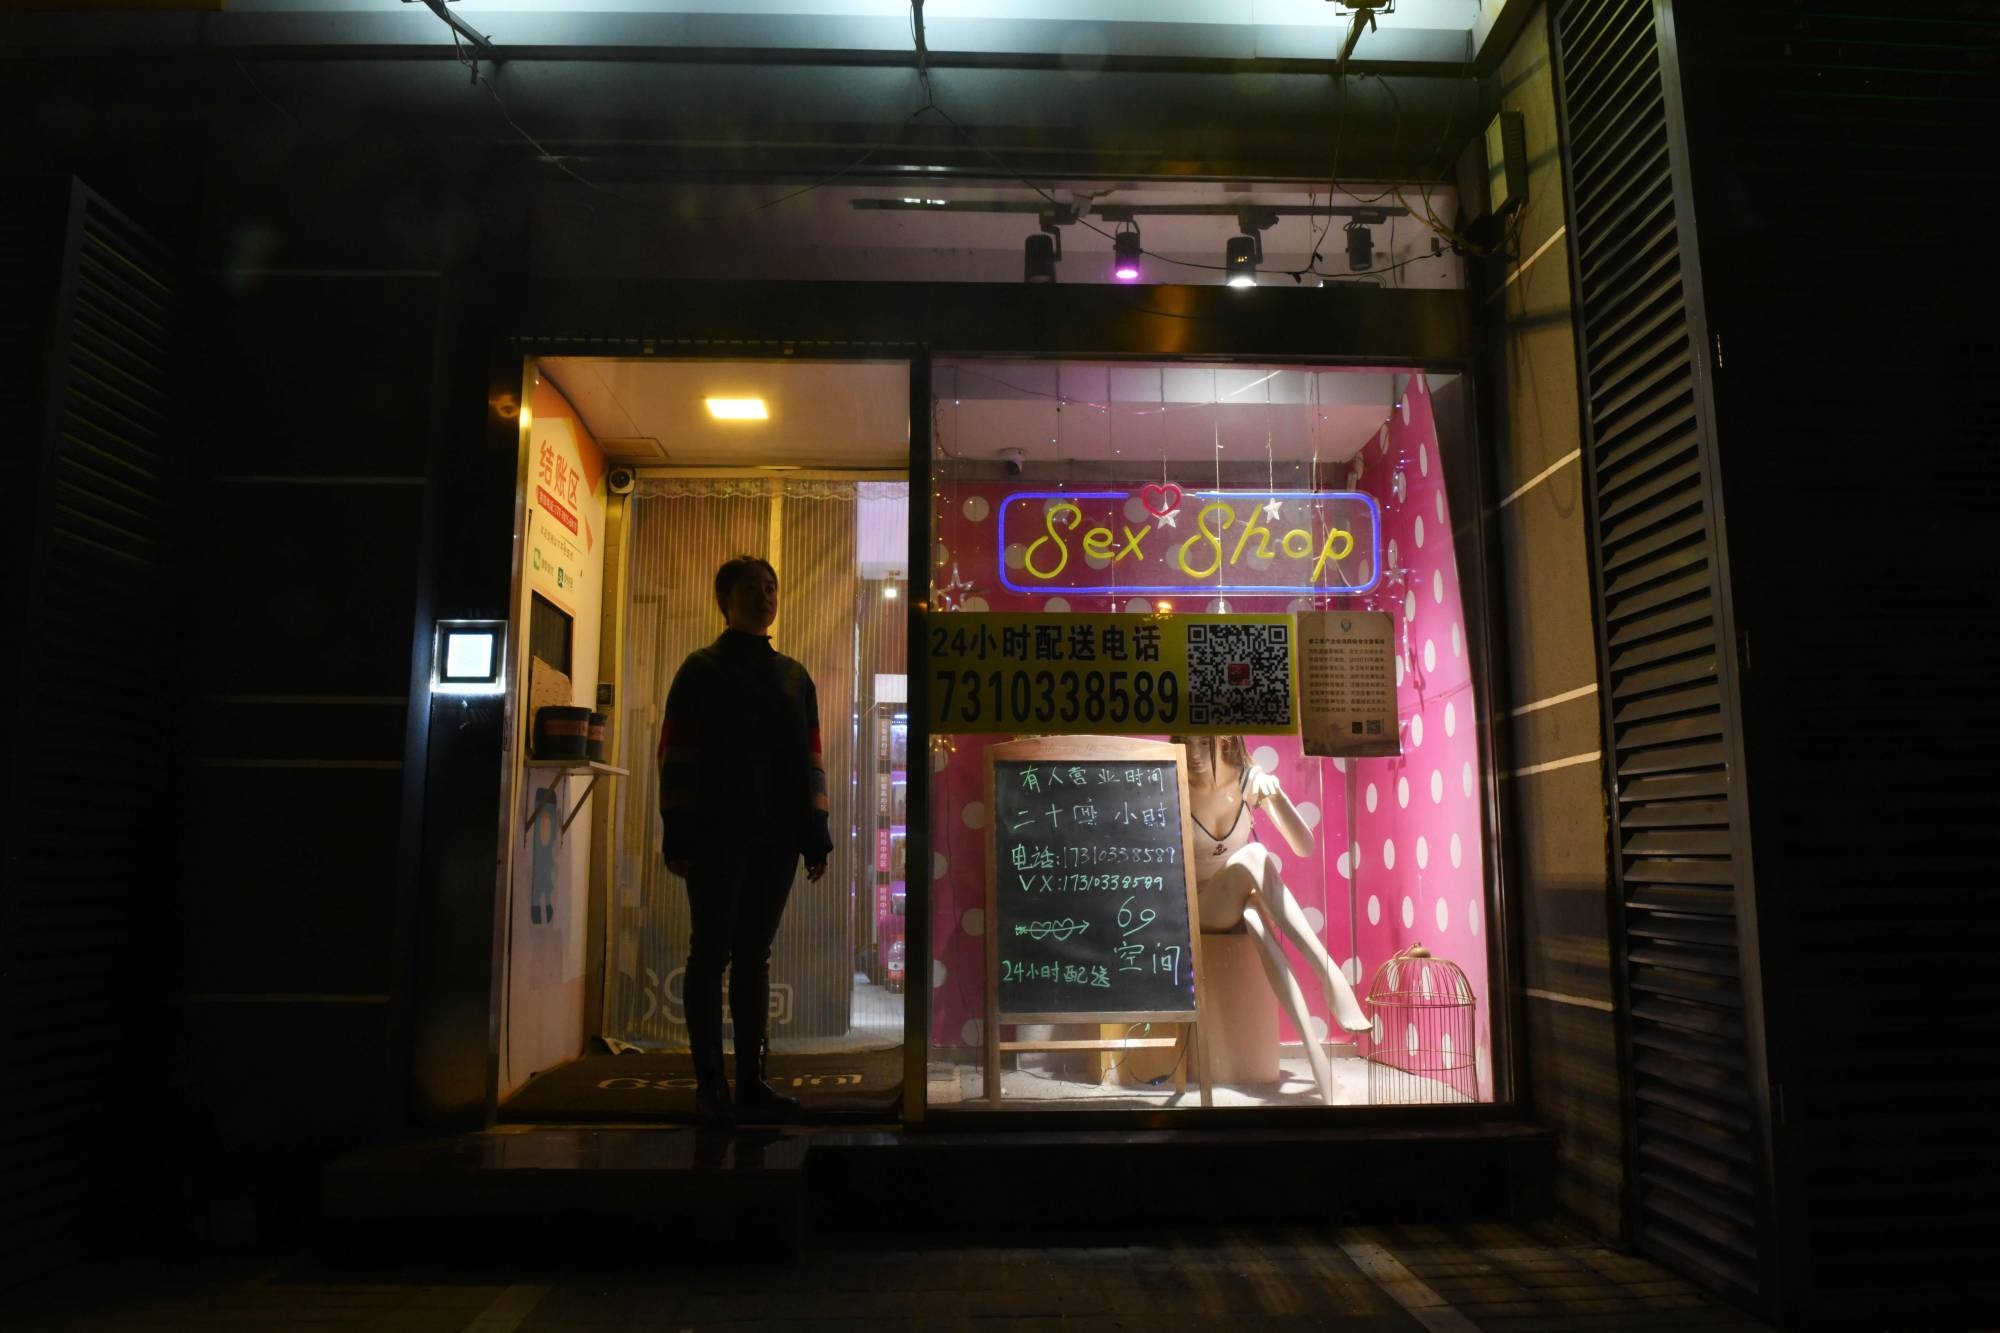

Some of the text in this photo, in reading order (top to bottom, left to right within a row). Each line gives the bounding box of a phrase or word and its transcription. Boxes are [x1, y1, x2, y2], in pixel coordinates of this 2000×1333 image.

[538, 440, 580, 511] 结账区
[1024, 503, 1355, 583] Sex Shop
[932, 624, 1161, 661] 24小时配送电话
[936, 670, 1179, 723] 7310338589
[1019, 766, 1165, 793] 有人营业时间
[1116, 895, 1157, 937] 69
[1113, 940, 1181, 987] 空间
